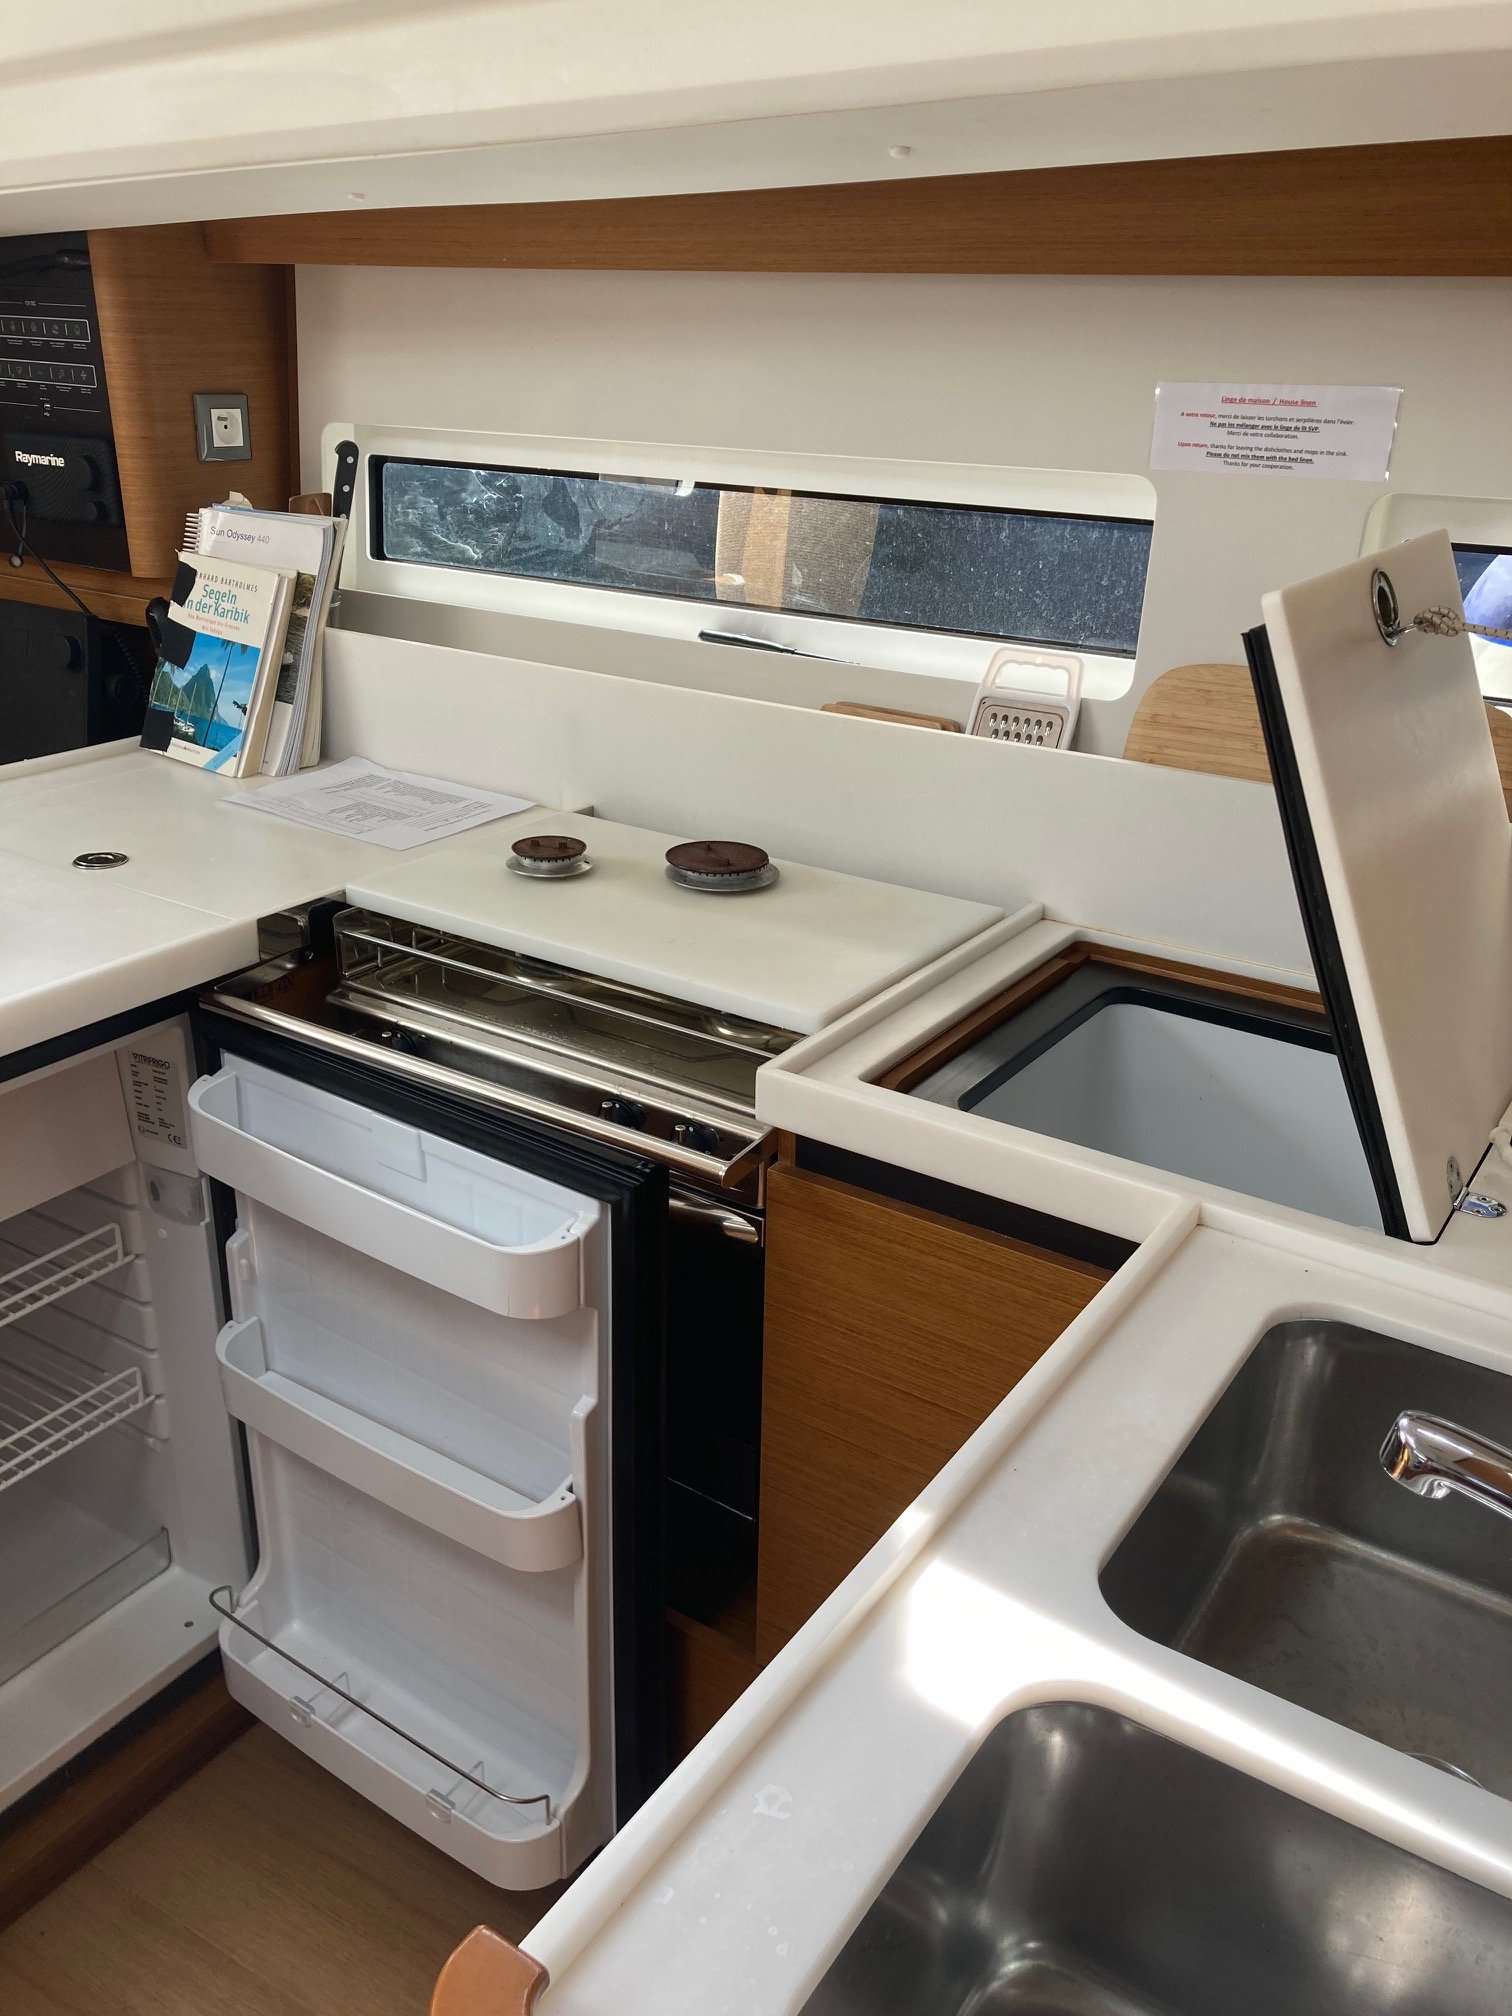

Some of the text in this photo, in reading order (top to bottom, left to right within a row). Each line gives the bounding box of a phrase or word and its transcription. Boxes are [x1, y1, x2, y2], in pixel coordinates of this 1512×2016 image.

[1221, 396, 1238, 404] Linge
[1300, 399, 1317, 407] linen
[15, 450, 65, 467] Raymarine
[210, 526, 270, 545] Sun Odyssey 440
[220, 577, 259, 593] BARTHOLMES
[202, 584, 238, 605] Segeln
[195, 597, 212, 615] der
[213, 602, 251, 625] Karibik
